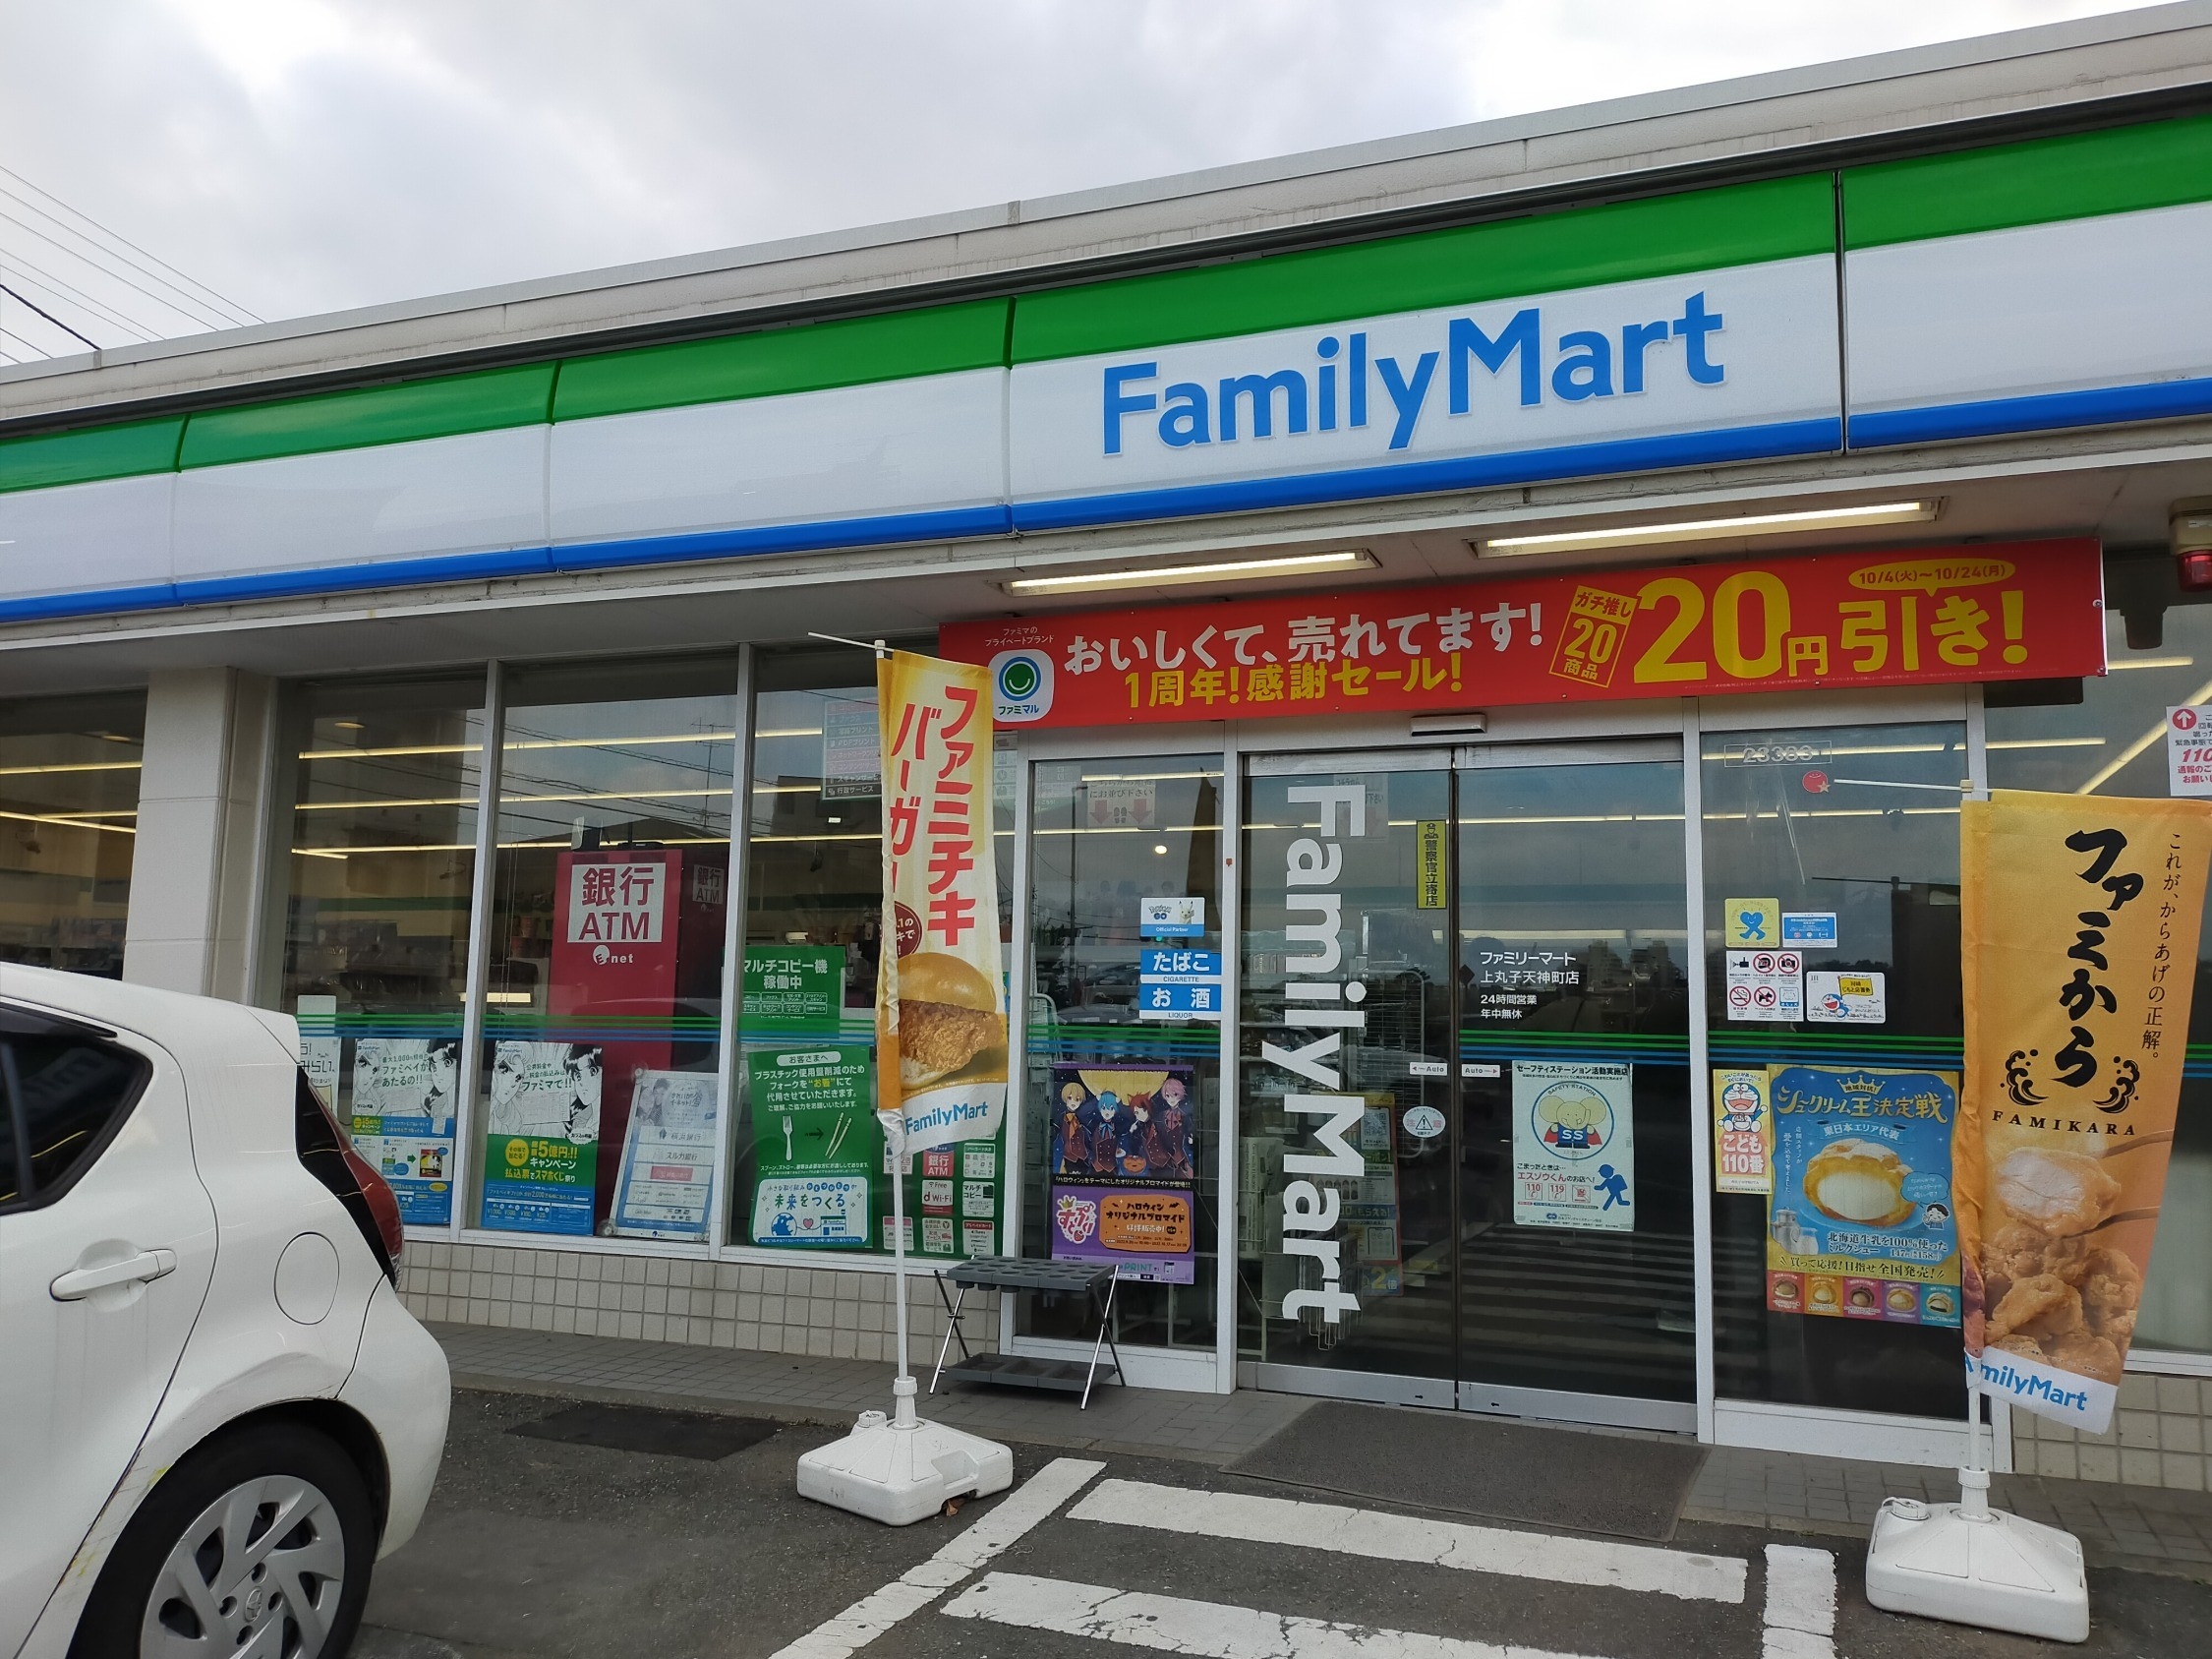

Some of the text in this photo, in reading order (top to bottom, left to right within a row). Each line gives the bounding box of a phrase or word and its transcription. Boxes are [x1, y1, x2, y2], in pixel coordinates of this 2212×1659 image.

[1102, 290, 1724, 455] FamilyMart
[1575, 591, 1632, 619] ガチ推し
[1003, 625, 1038, 635] ファミマの
[984, 633, 1055, 647] プライベートブランド
[1563, 618, 1617, 664] 20
[1563, 658, 1599, 681] 商品
[998, 703, 1040, 716] ファミマル
[1742, 744, 1815, 764] 23383
[2183, 748, 2212, 763] 110
[927, 685, 979, 947] ファミチキ
[582, 866, 655, 907] 銀行
[696, 887, 720, 902] ATM
[578, 912, 650, 940] ATM
[2141, 833, 2183, 1060] これが、からあげの正解。
[1152, 951, 1210, 972] たばこ
[1480, 952, 1577, 966] ファミリーマート
[2050, 828, 2144, 1088] ファミから
[744, 959, 828, 974] マルチコピー機
[763, 975, 802, 989] 稼働中
[1480, 971, 1580, 984] 上丸子天神町店
[1152, 987, 1211, 1009] お酒
[1480, 994, 1538, 1005] 24時間営業
[1480, 1009, 1523, 1020] 年中無休
[788, 1054, 829, 1063] お客さまへ
[1262, 785, 1367, 1324] FamilyMart
[754, 1065, 865, 1080] プラスチック使用量削減のため
[1426, 1063, 1444, 1072] Auto
[1516, 1065, 1629, 1077] セーフティステーション活動実施店
[767, 1089, 857, 1102] 代用させていただきます。
[1547, 1084, 1597, 1096] SAFETY STATION
[1776, 1086, 1949, 1124] シュークリーム王決定戦
[904, 1100, 989, 1135] FamilyMart
[1992, 1109, 2136, 1136] FAMIKARA
[1561, 1130, 1584, 1141] SS
[1824, 1123, 1900, 1141] 東日本エリア代表
[1722, 1134, 1763, 1154] こども
[530, 1157, 576, 1169] キャンペーン
[928, 1155, 949, 1167] 銀行
[1721, 1154, 1765, 1174] 110番
[775, 1193, 845, 1211] 未来をつくる
[924, 1192, 931, 1202] d
[1126, 1202, 1165, 1212] ハロウィン
[1106, 1212, 1186, 1223] オリジナルブロマイド
[1828, 1231, 1949, 1252] 北海道牛乳を100%使った
[1828, 1243, 1880, 1254] ミルクシュー
[1124, 1263, 1152, 1272] PRINT
[1980, 1364, 2088, 1411] milyMart
